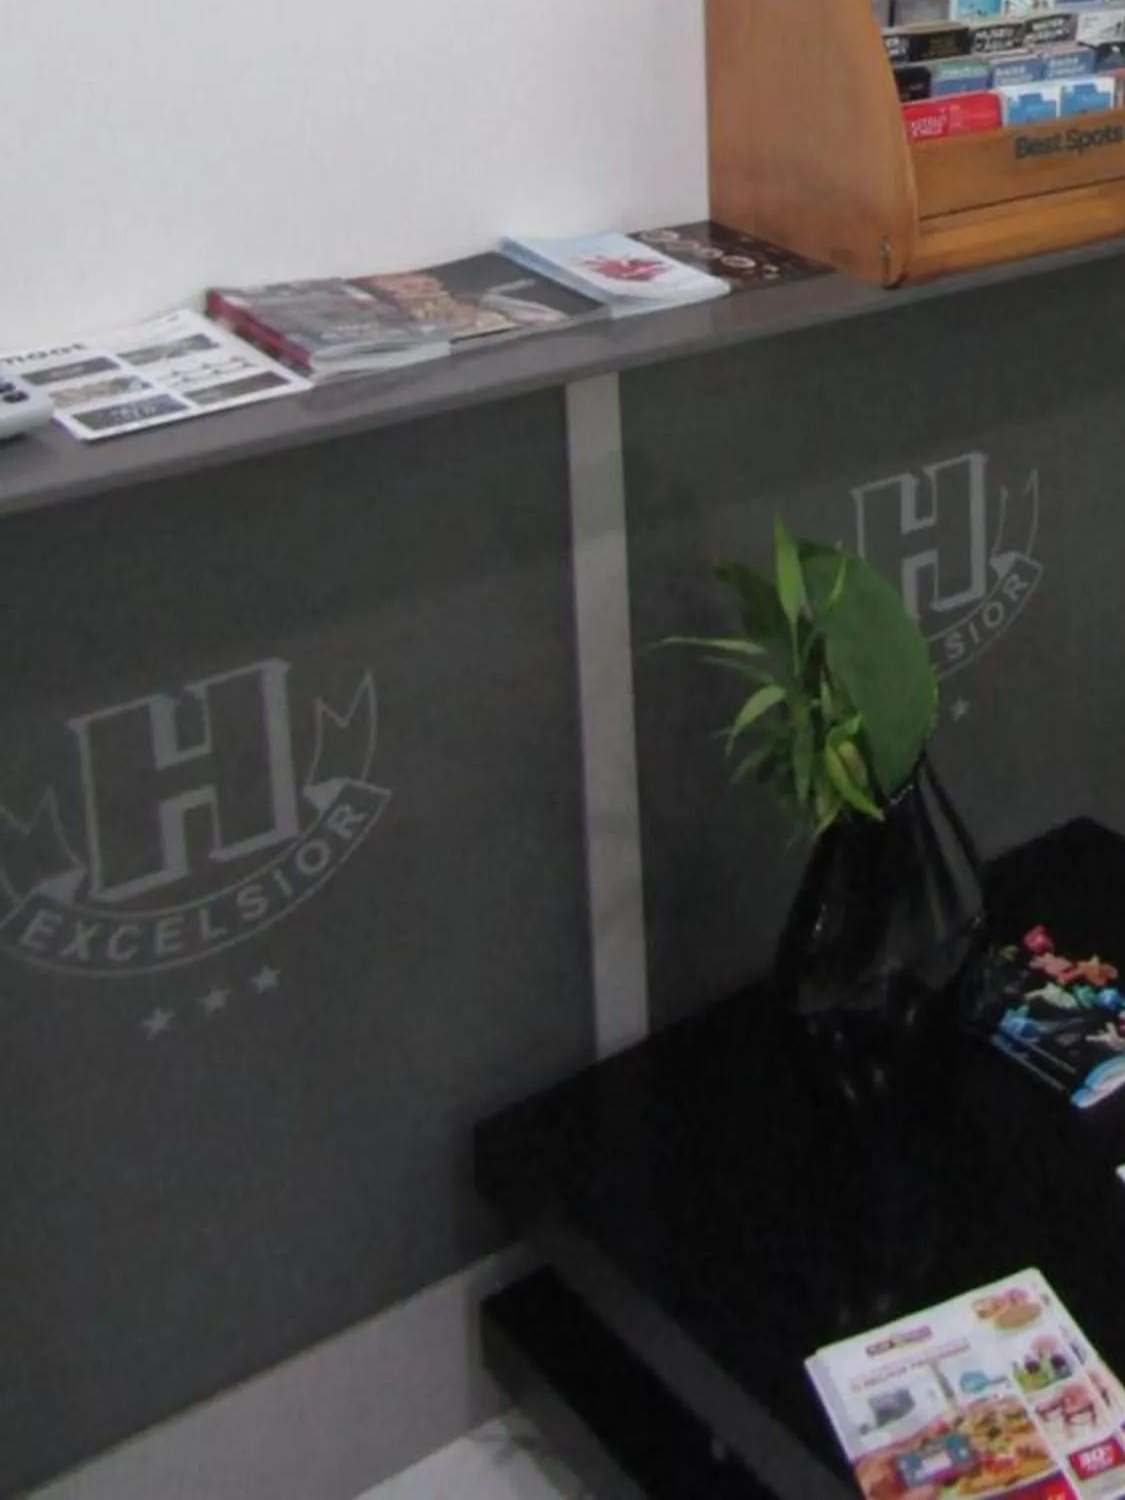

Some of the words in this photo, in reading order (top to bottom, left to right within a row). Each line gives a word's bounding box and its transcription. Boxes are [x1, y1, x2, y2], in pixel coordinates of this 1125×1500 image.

[1065, 123, 1123, 155] Spots
[65, 657, 299, 900] H
[20, 804, 366, 962] EXCELSIOR
